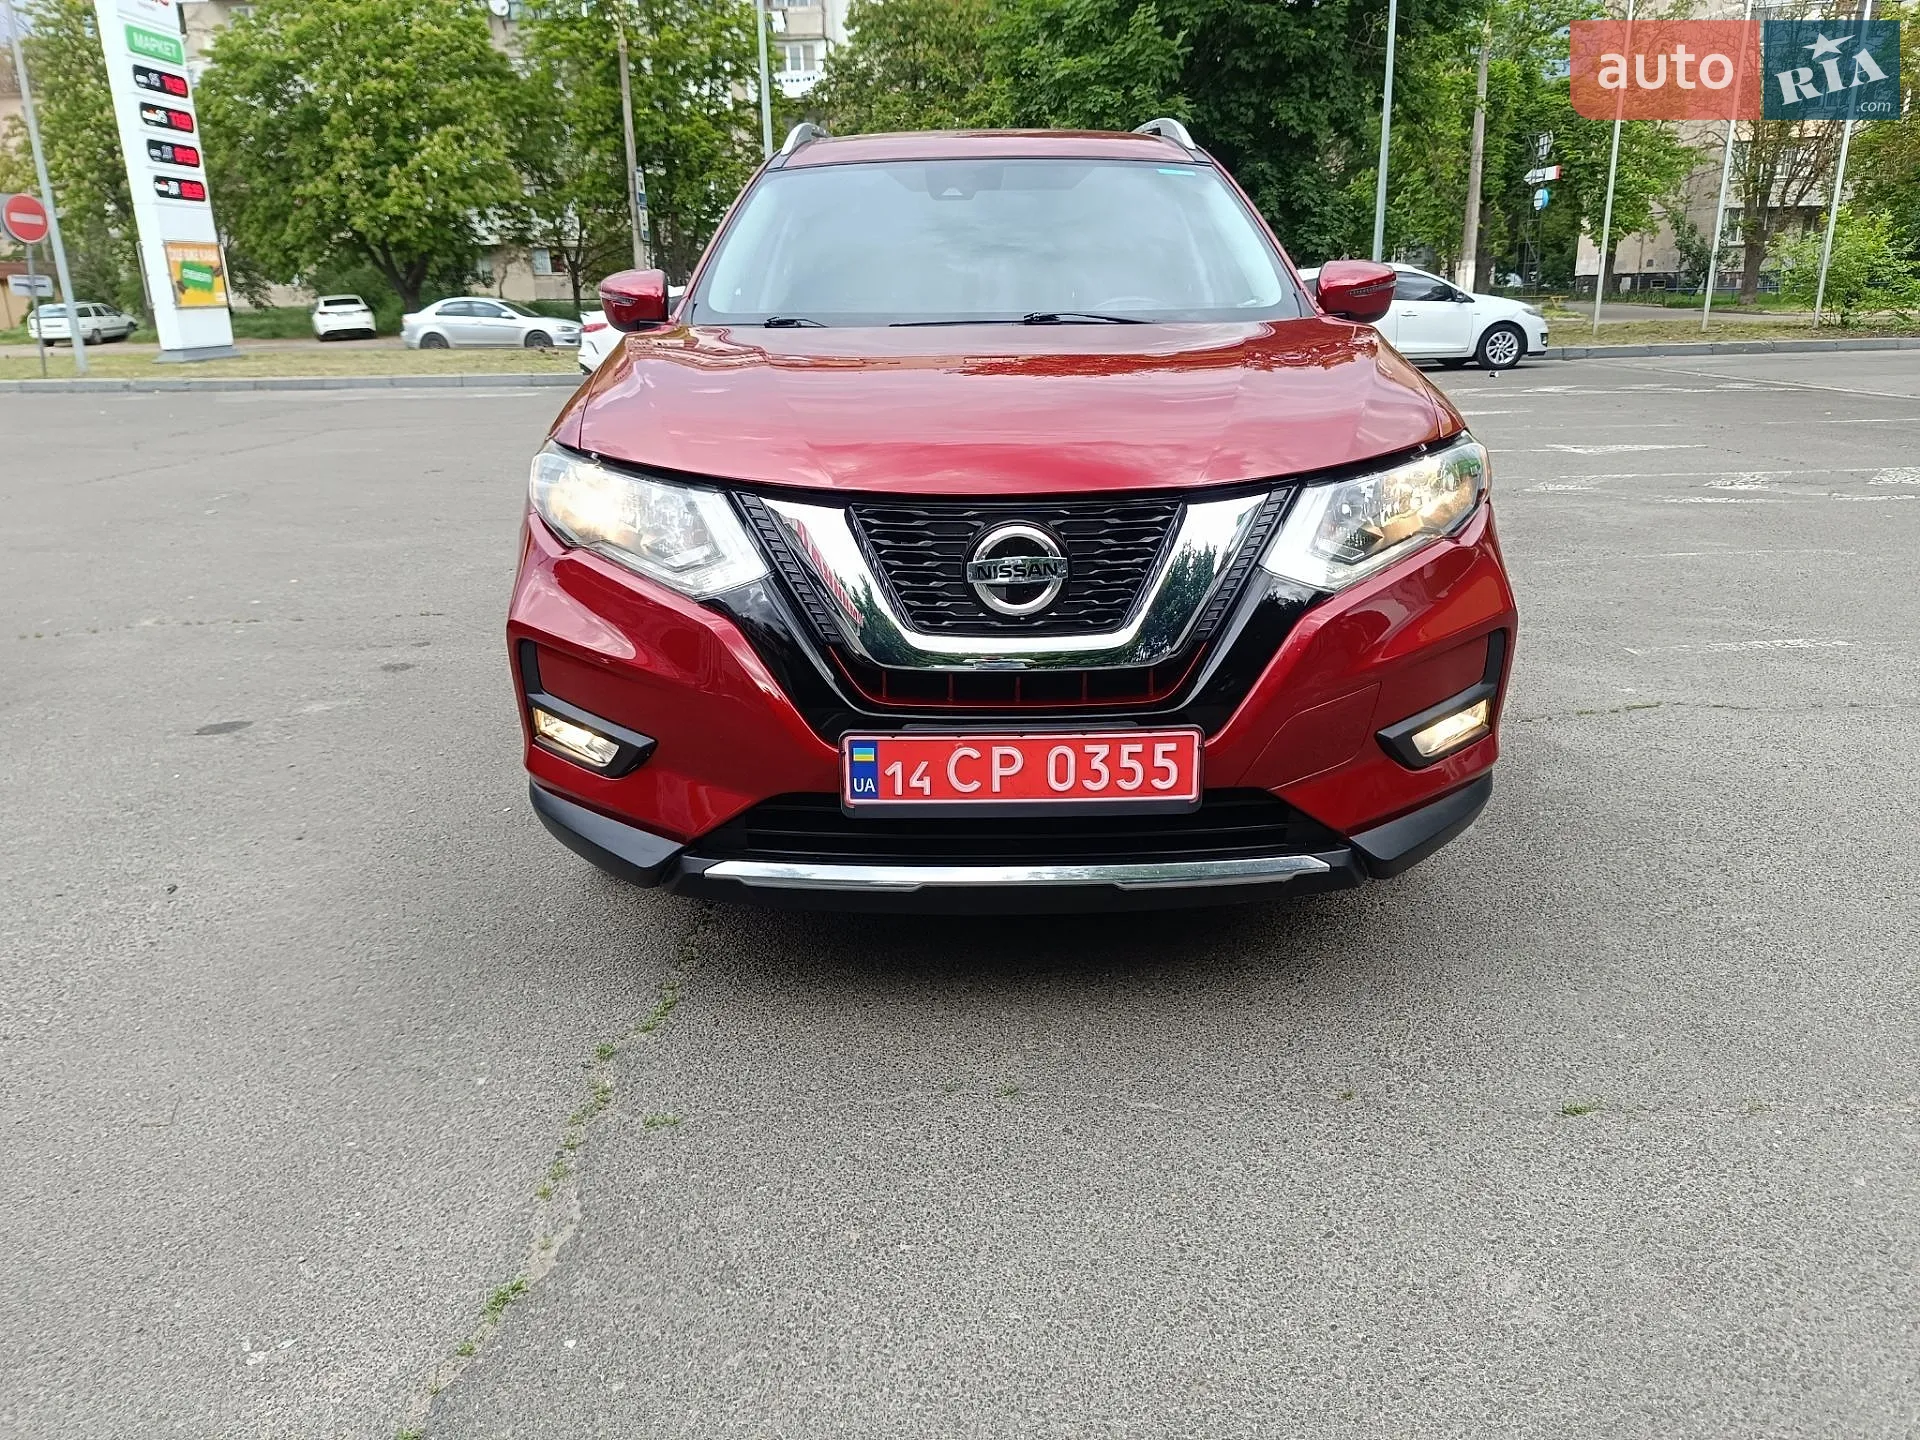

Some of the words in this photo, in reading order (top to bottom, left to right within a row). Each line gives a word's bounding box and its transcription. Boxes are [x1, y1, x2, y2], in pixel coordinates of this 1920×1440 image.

[132, 31, 178, 58] МАРКЕТ
[976, 562, 1059, 579] NISSAN
[884, 761, 932, 796] 14
[947, 746, 1025, 793] CP
[1047, 743, 1178, 792] 0355
[853, 777, 876, 793] UA
